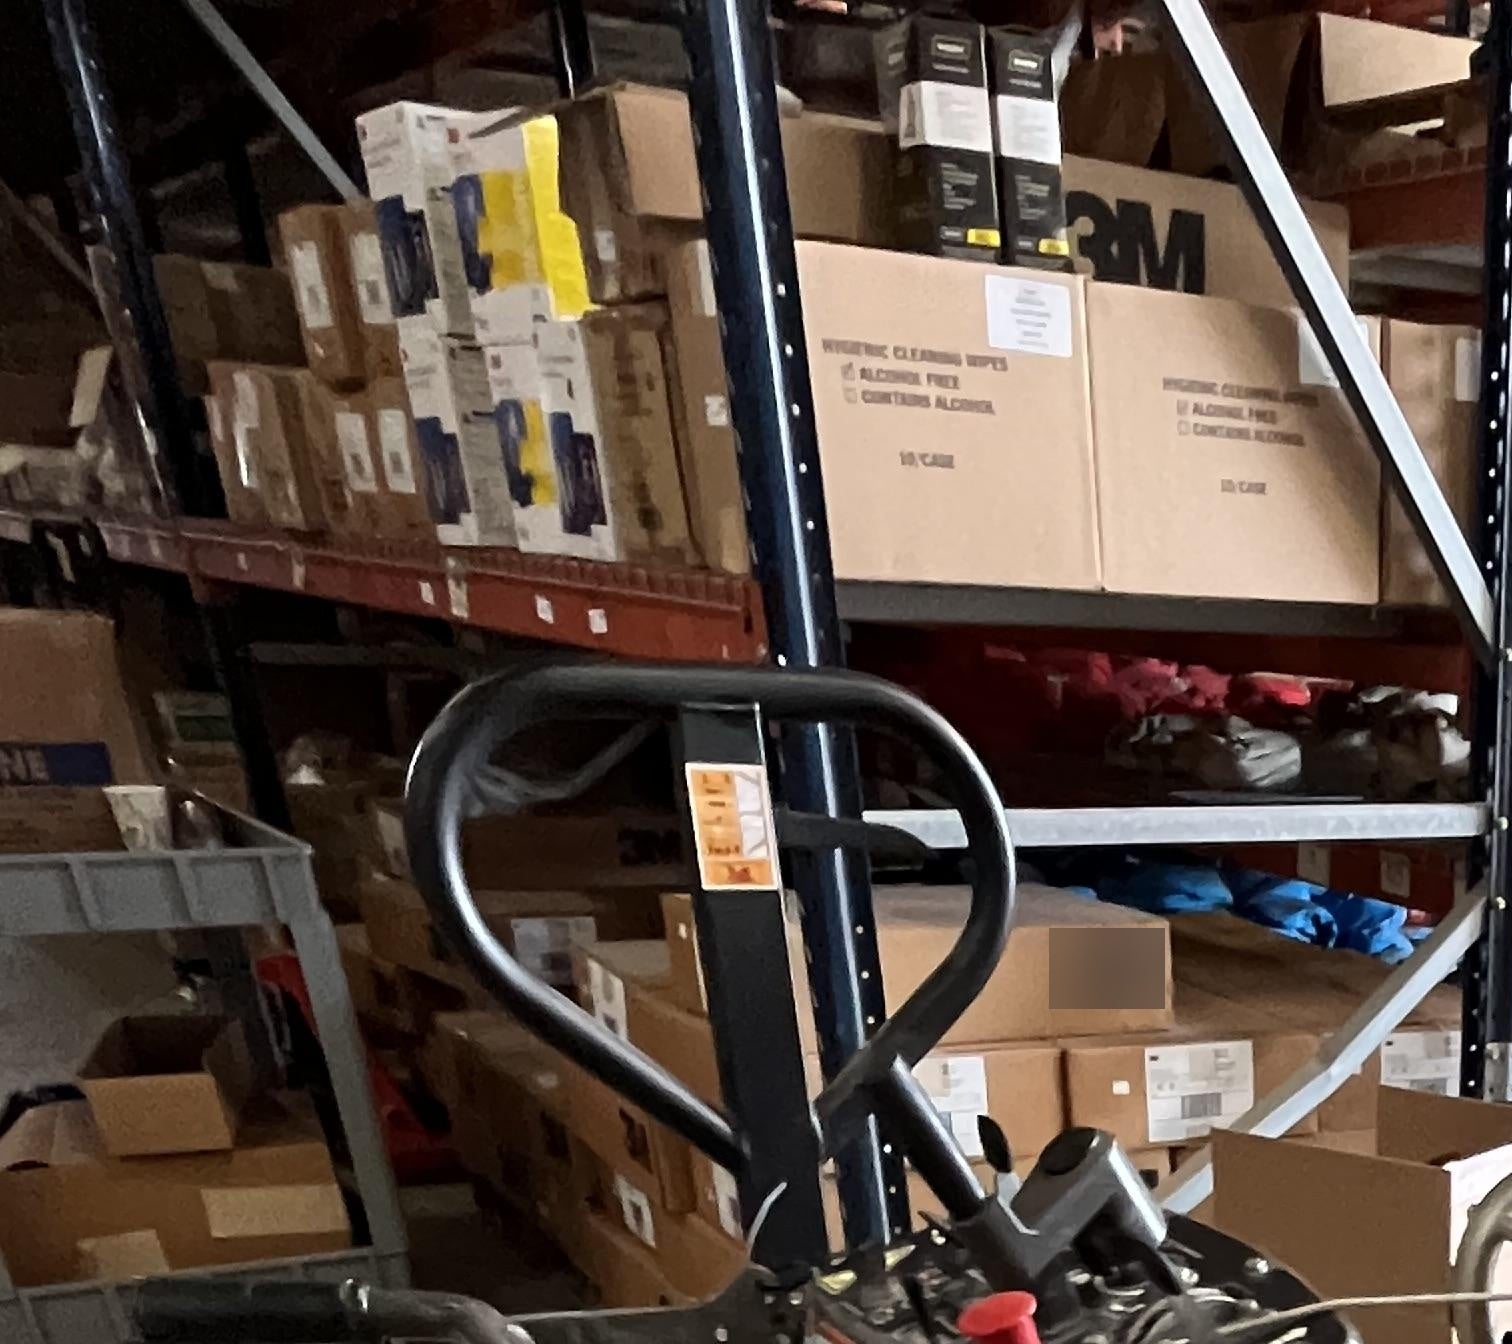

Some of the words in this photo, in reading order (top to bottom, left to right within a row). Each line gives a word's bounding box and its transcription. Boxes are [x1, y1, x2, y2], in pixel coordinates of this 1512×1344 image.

[1066, 191, 1205, 294] 3M
[859, 366, 921, 385] ALCOHOL
[926, 372, 959, 390] FREE
[934, 395, 995, 416] ALCOHOL
